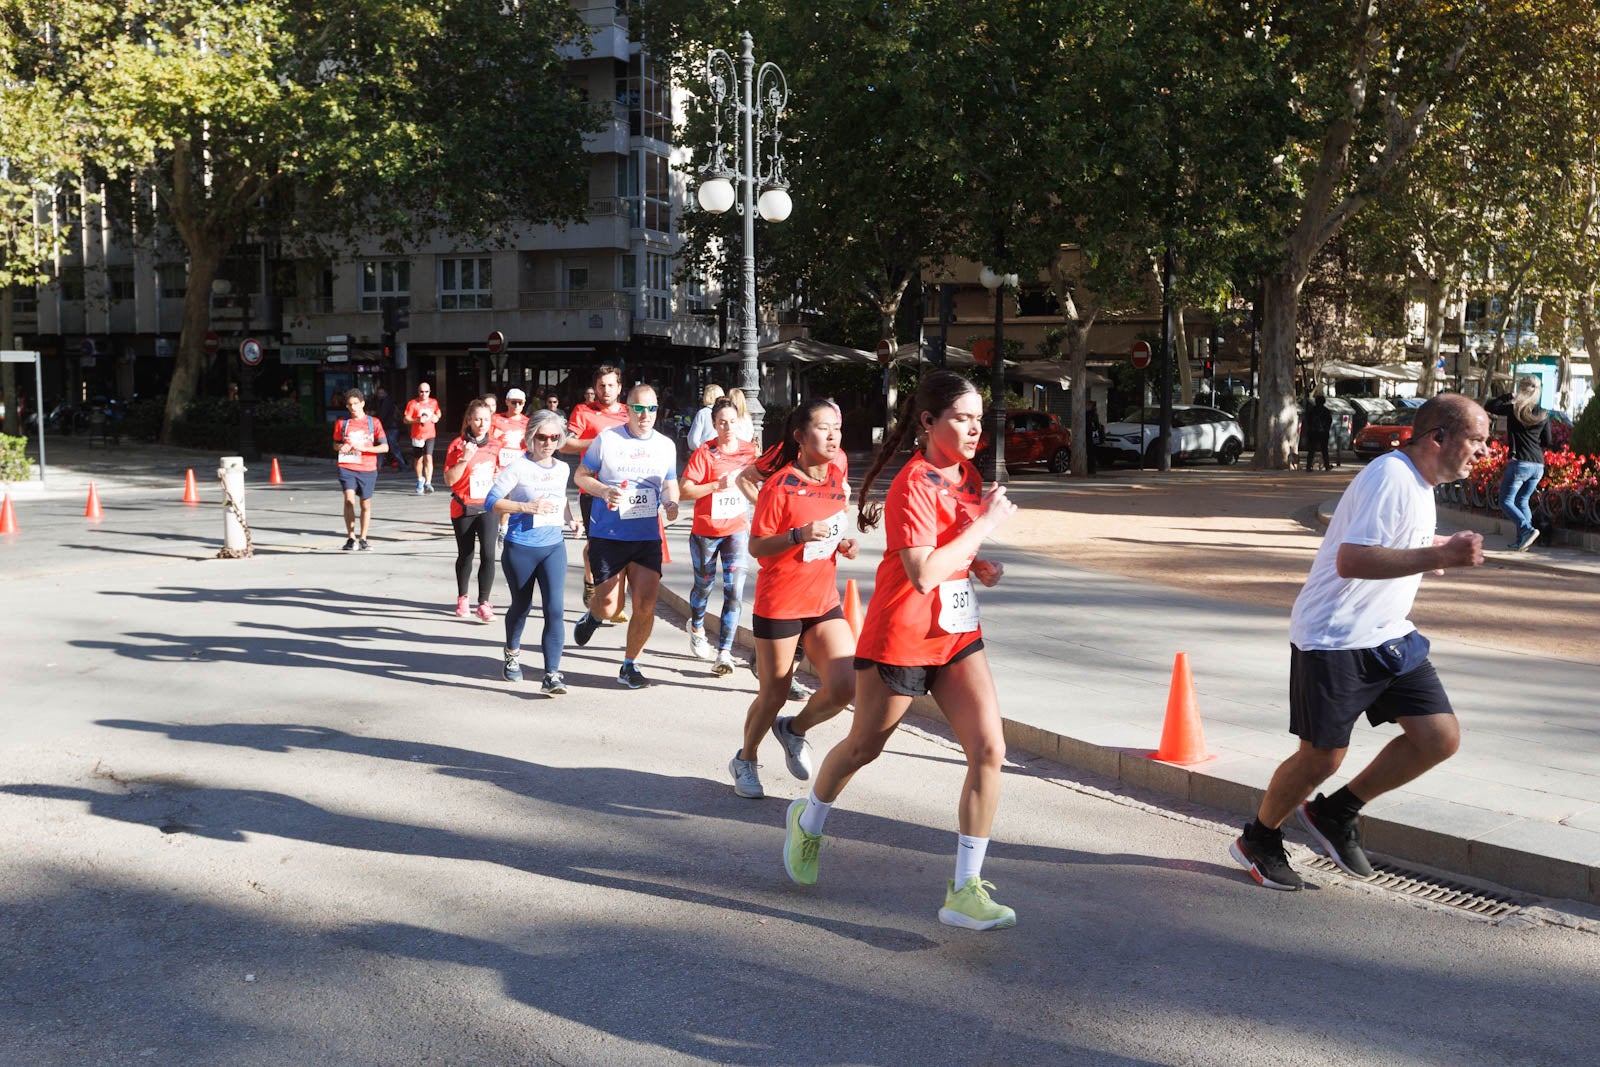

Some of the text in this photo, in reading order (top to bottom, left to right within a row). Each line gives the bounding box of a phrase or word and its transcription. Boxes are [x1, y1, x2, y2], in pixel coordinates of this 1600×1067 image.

[628, 494, 648, 506] 628
[718, 496, 740, 506] 1701
[952, 591, 969, 609] 387
